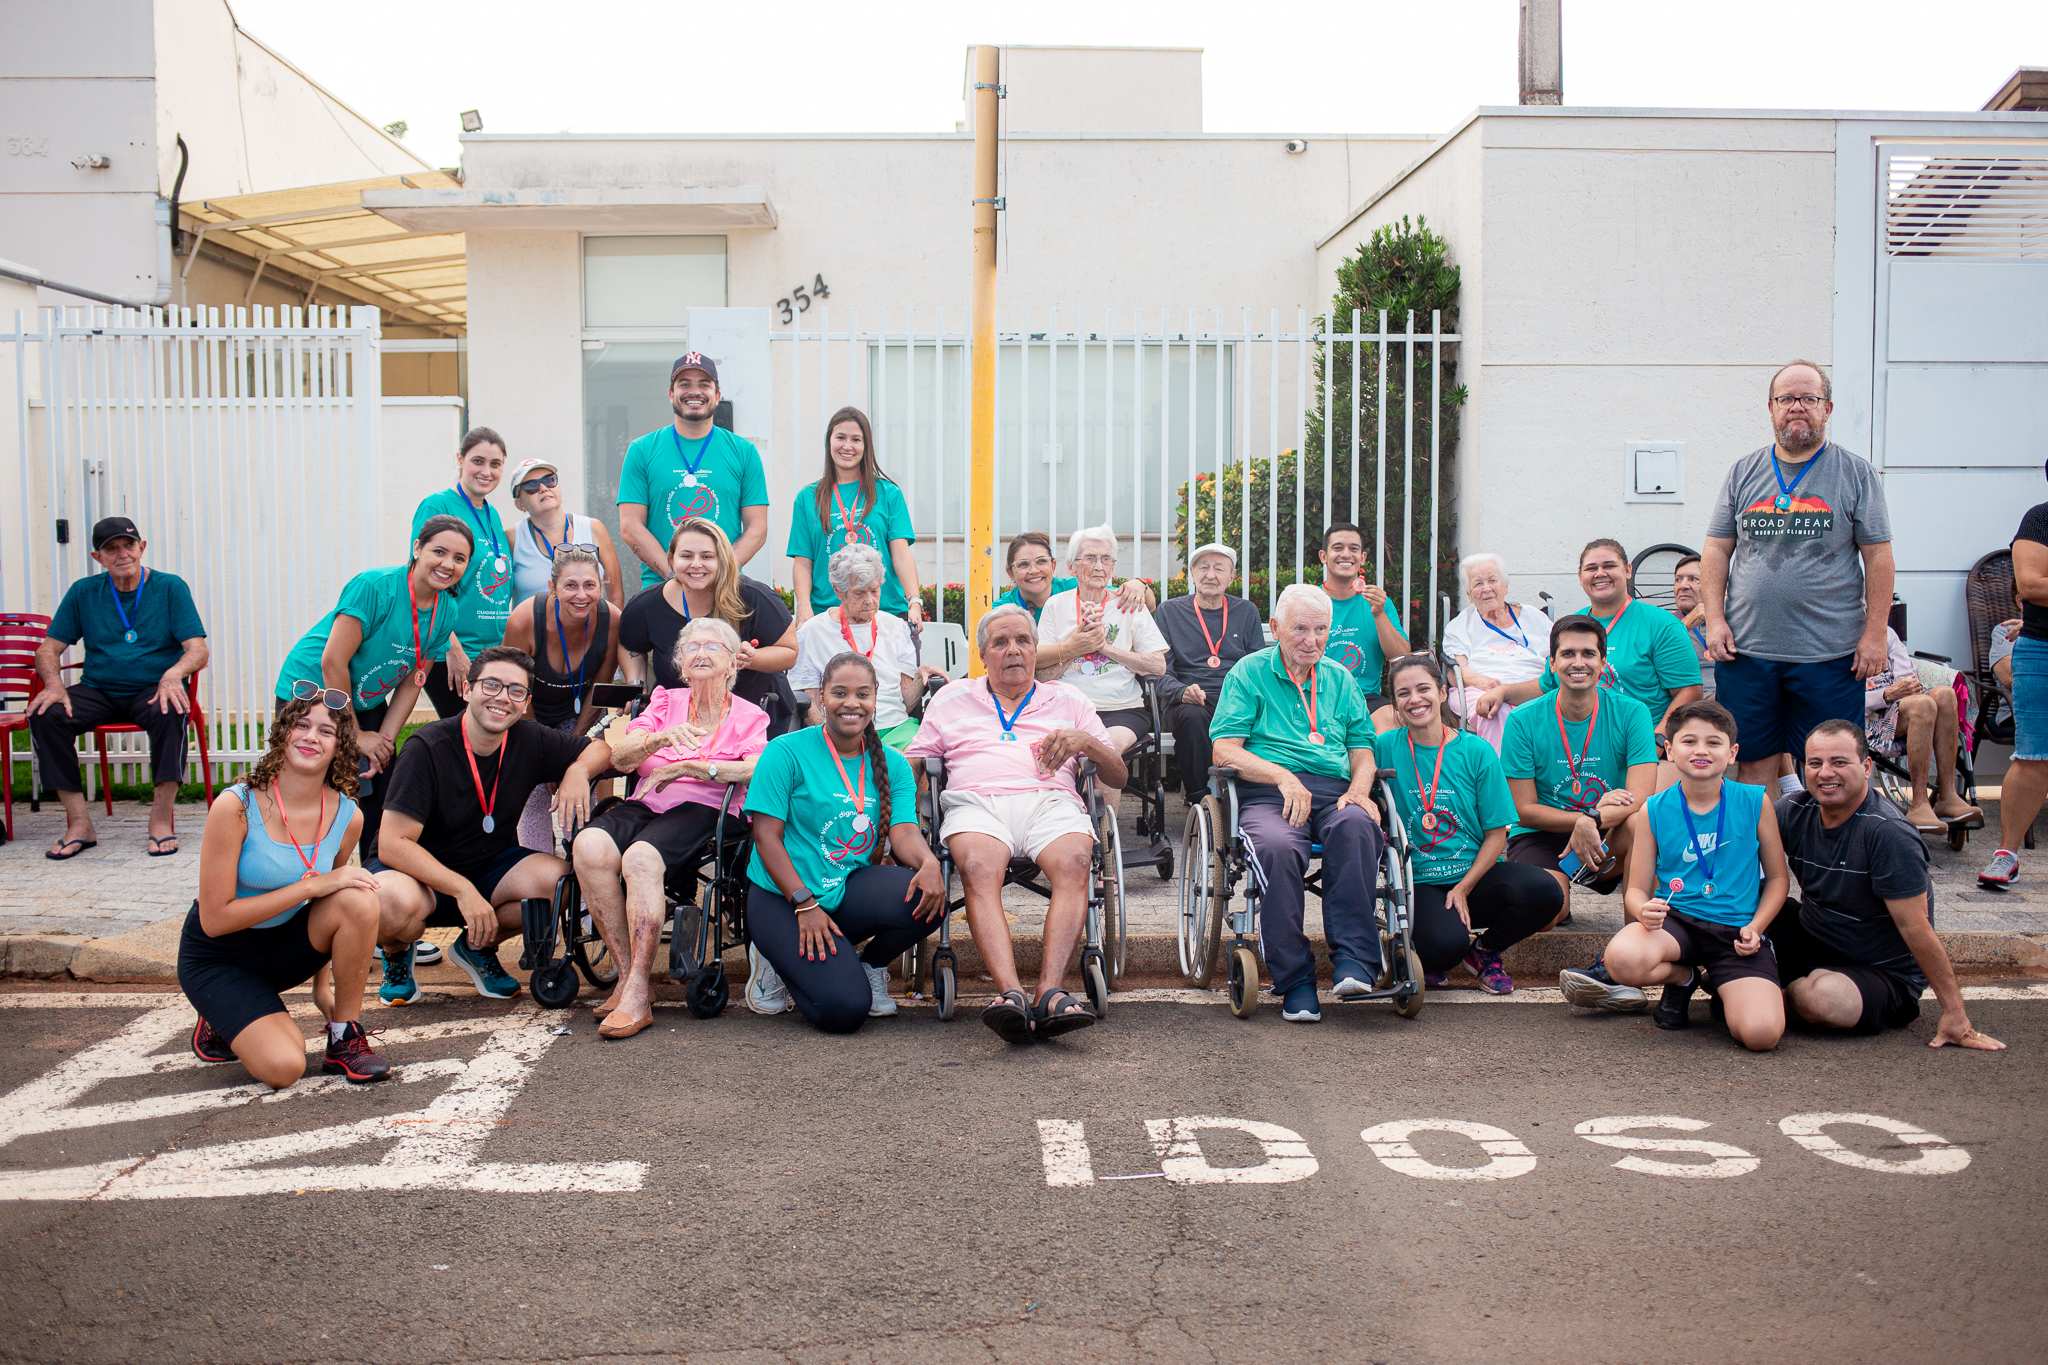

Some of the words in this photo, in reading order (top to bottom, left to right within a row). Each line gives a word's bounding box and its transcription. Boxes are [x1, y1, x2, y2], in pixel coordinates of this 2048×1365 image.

[776, 273, 830, 325] 354
[1742, 518, 1785, 528] BROAD
[1794, 518, 1831, 528] PEAK
[821, 820, 833, 835] vida
[1689, 832, 1717, 849] NIK
[1036, 1112, 1972, 1187] IDOSO
